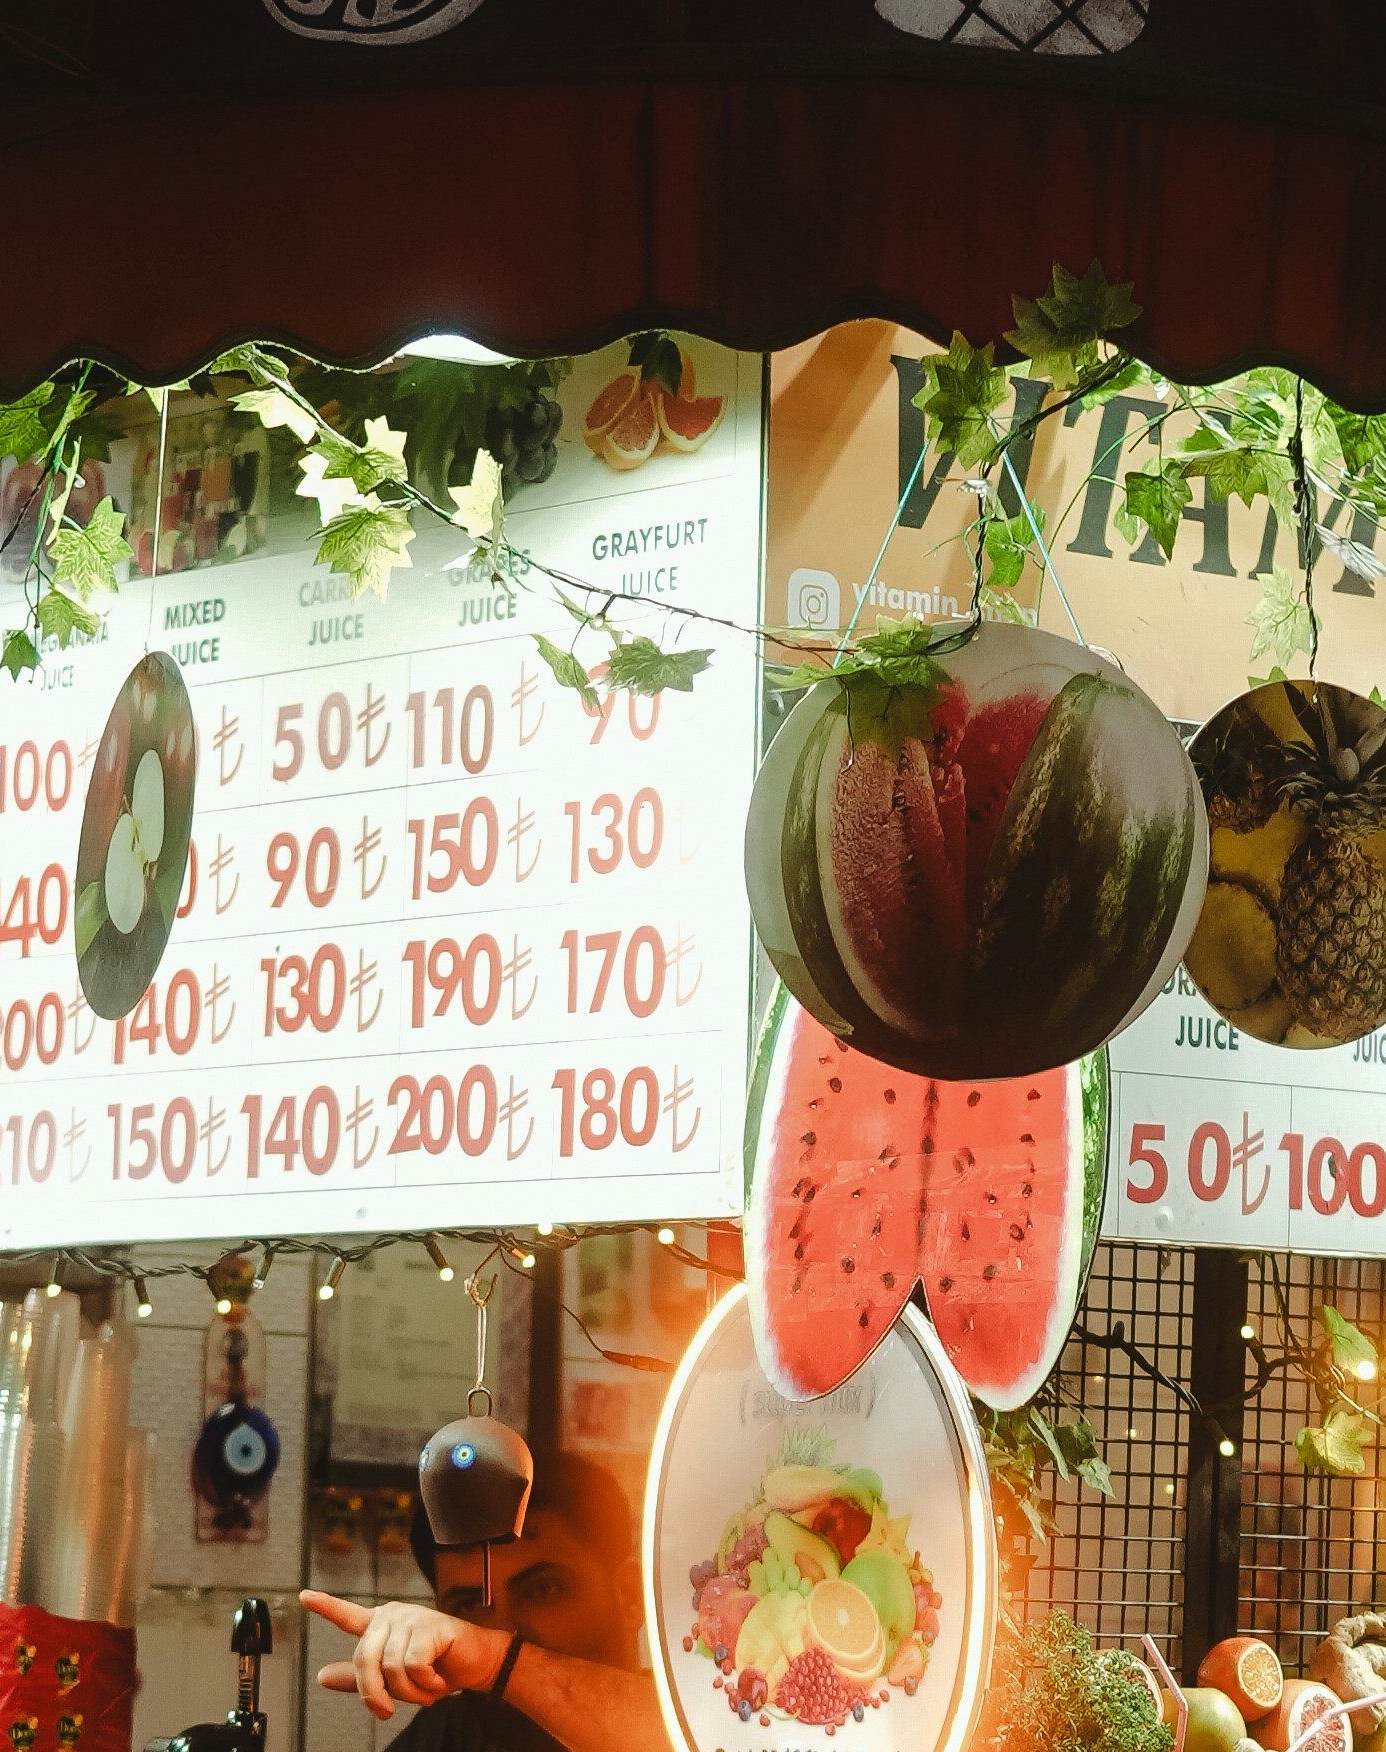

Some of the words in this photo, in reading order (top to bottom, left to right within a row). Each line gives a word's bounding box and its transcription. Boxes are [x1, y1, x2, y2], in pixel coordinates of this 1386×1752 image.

[592, 518, 708, 563] GRAYFURT
[619, 565, 679, 597] JUICE
[164, 597, 227, 630] MIXED
[457, 595, 518, 628] JUICE
[309, 614, 365, 647] JUICE
[170, 636, 221, 668] JUICE
[1174, 1014, 1240, 1051] JUICE
